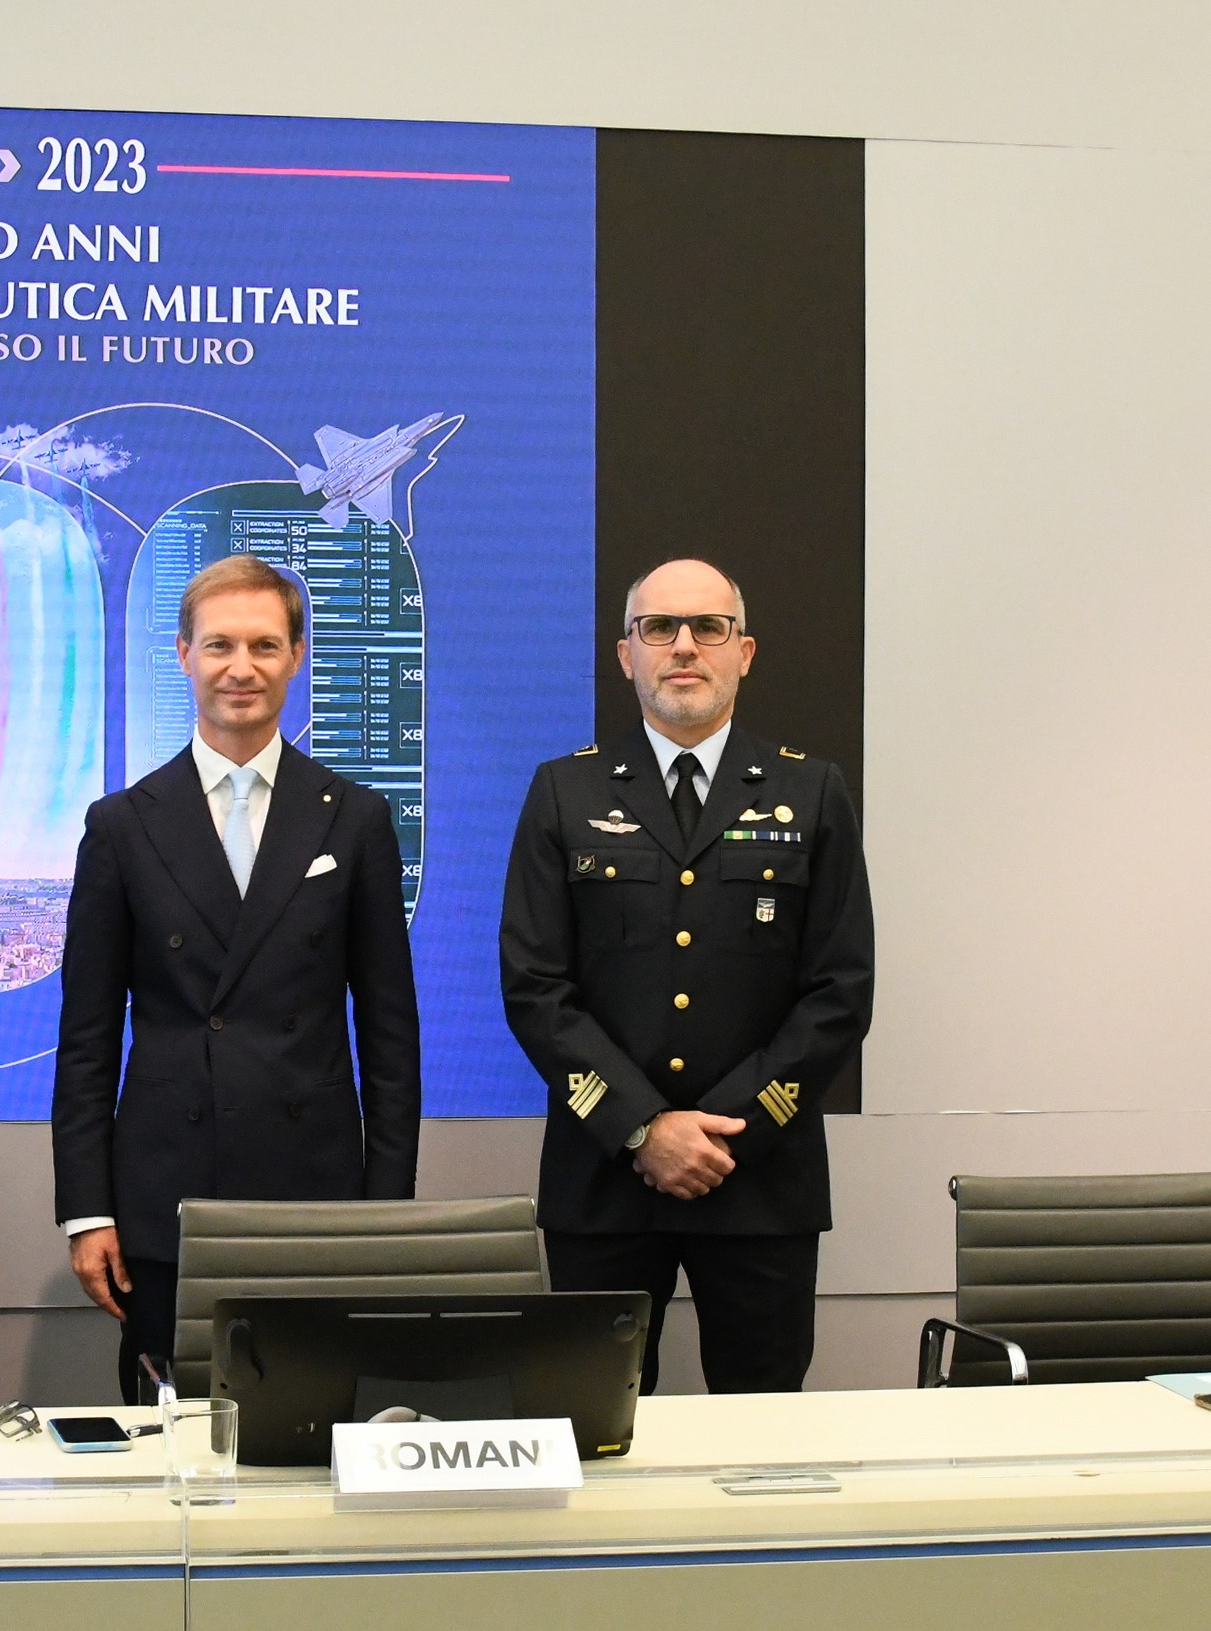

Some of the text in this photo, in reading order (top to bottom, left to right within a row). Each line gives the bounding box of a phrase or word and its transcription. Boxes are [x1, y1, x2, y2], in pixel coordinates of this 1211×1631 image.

[37, 136, 146, 194] 2023
[31, 223, 160, 263] ANNI
[143, 284, 359, 326] MILITARE
[59, 334, 87, 362] IL
[102, 336, 254, 366] FUTURO
[291, 526, 307, 535] 50
[291, 543, 307, 553] 34
[291, 560, 307, 571] 84
